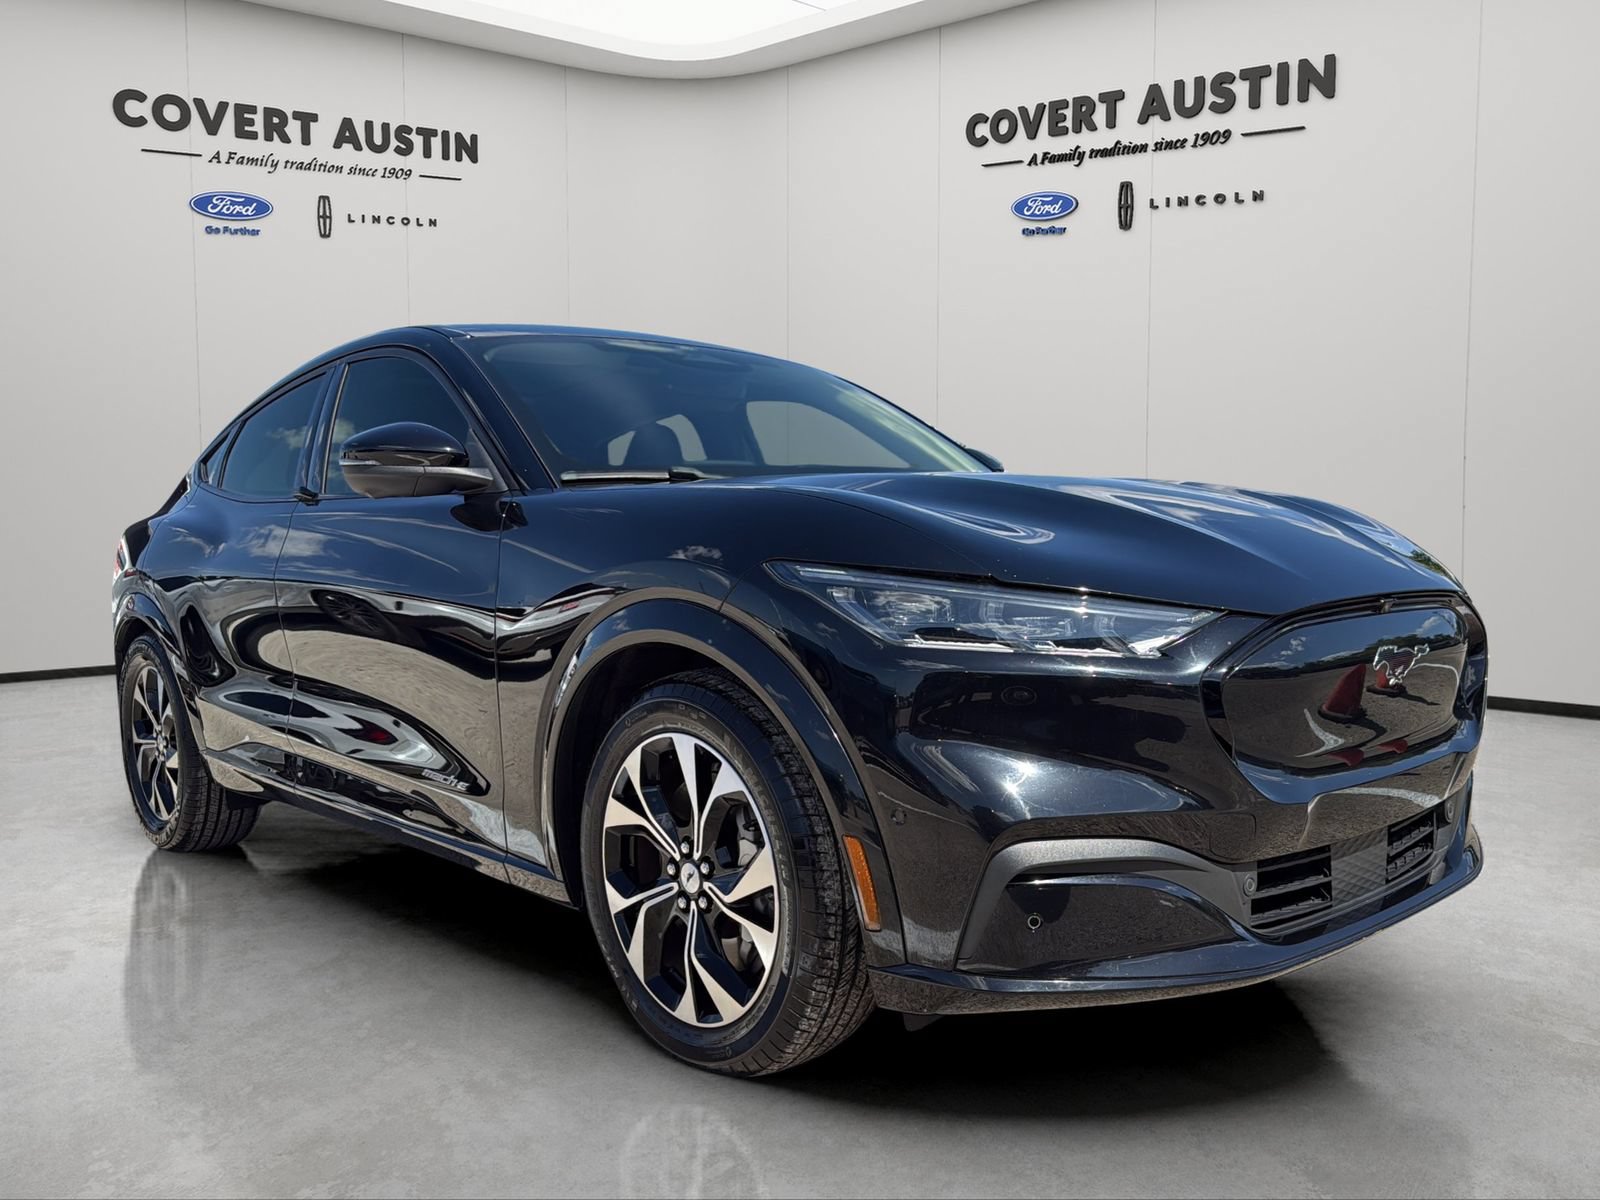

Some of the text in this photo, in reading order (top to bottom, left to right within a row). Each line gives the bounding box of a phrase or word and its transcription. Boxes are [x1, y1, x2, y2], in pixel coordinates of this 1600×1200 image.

[965, 53, 1337, 148] COVERT AUSTIN
[112, 88, 479, 164] COVERT AUSTIN
[1026, 128, 1233, 168] A Family tradition since 1909
[208, 150, 413, 181] A Family tradition since 1909
[207, 195, 257, 215] Ford
[1023, 197, 1063, 215] Ford
[1149, 189, 1265, 210] LINCOLN
[204, 225, 261, 236] Go Further
[347, 213, 438, 228] LINCOLN
